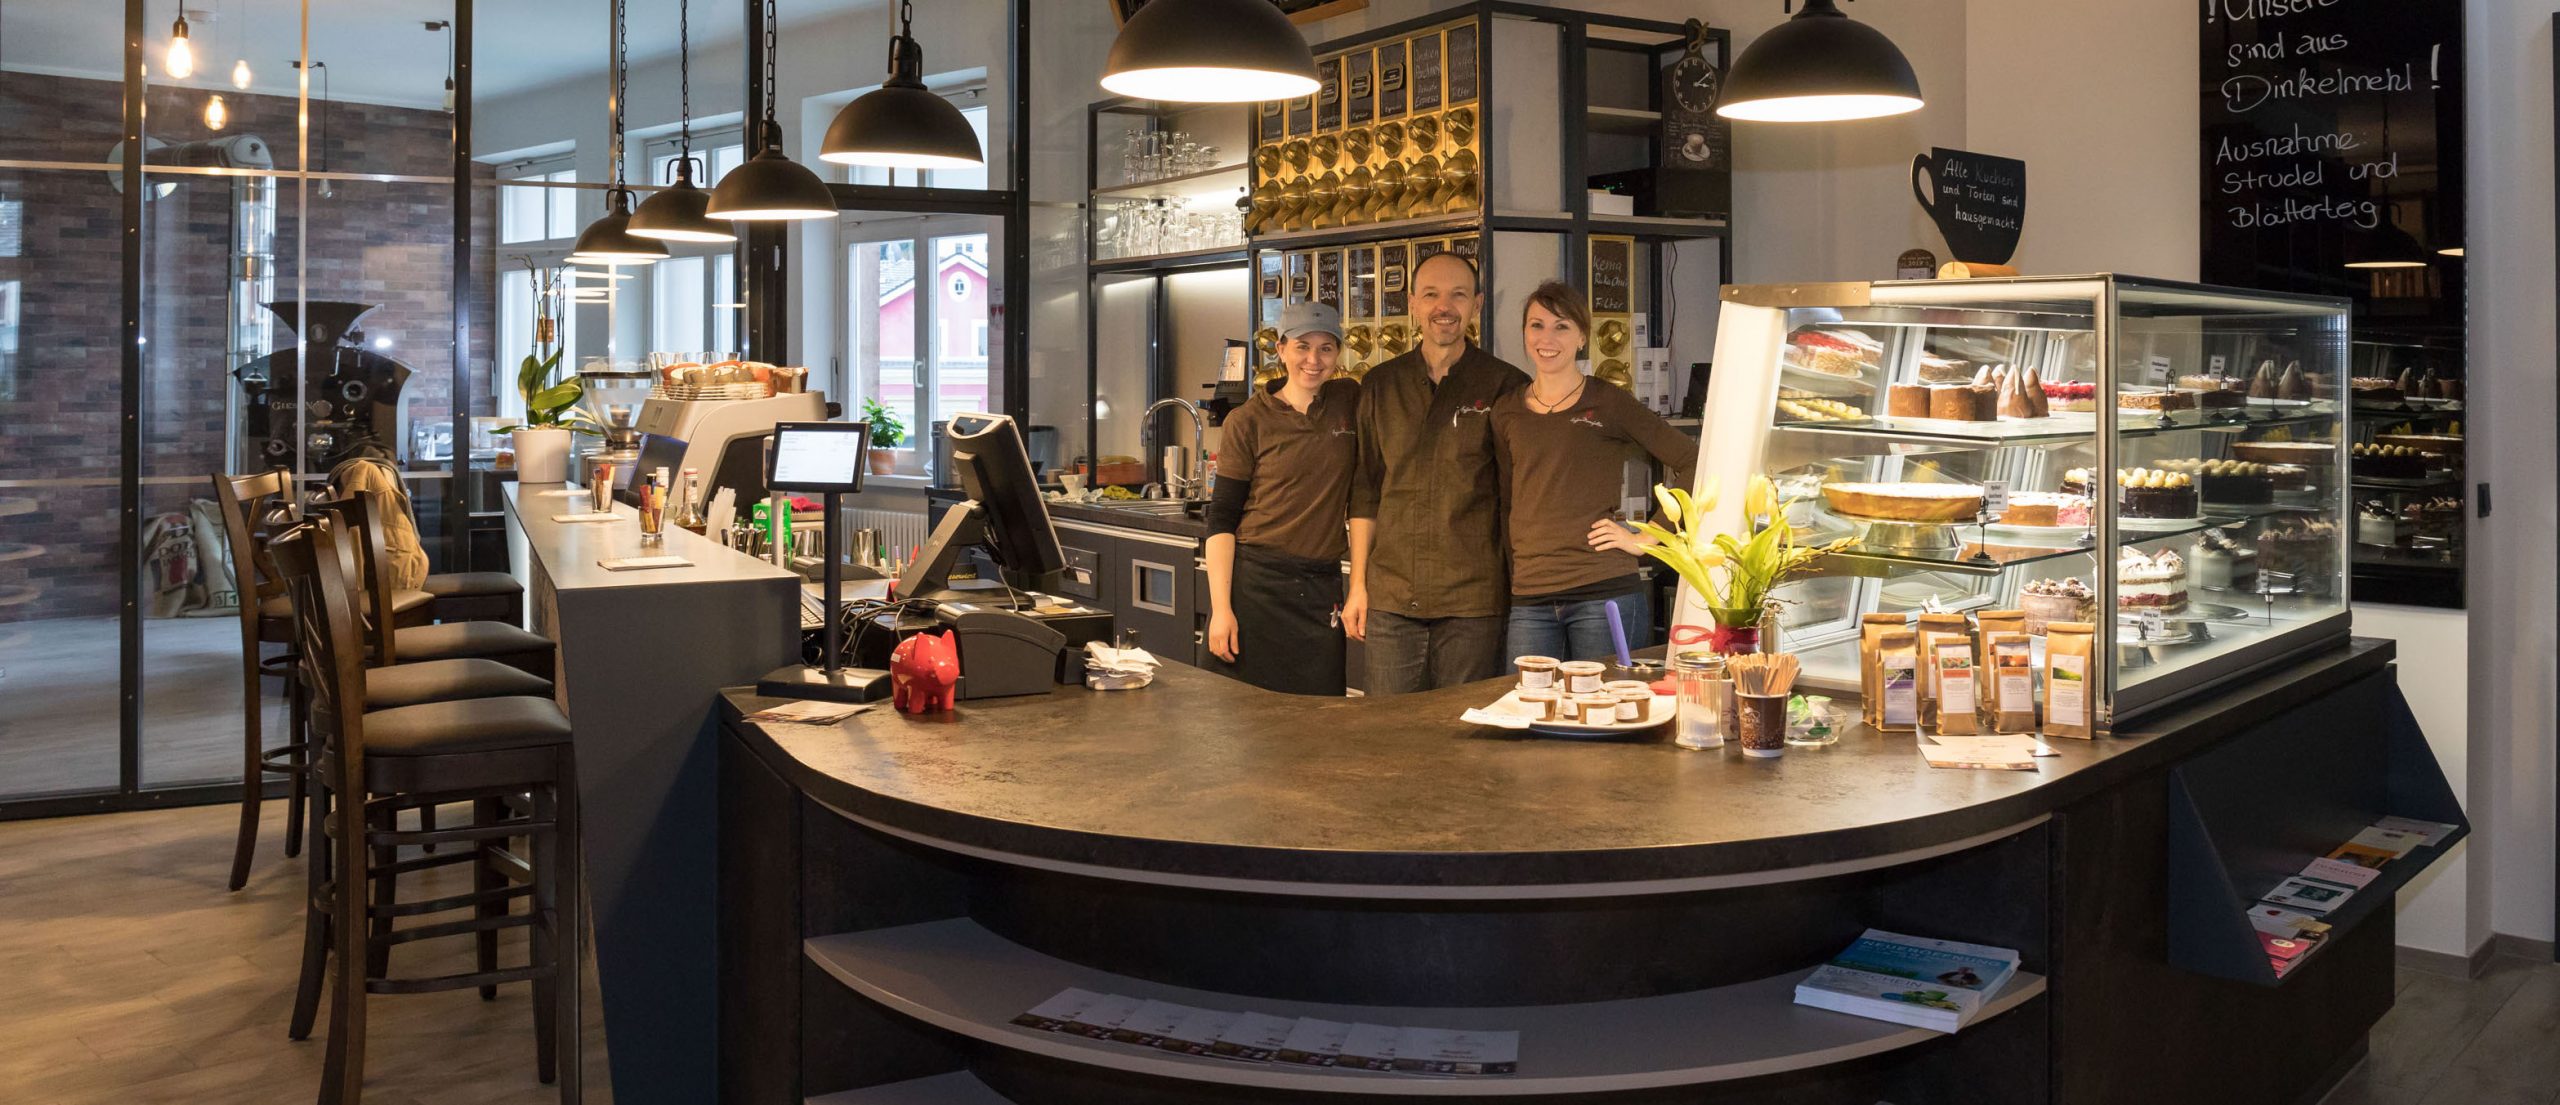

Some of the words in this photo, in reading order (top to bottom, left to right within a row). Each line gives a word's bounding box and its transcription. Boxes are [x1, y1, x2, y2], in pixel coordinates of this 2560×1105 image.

[2296, 33, 2348, 55] aus
[2221, 63, 2412, 113] Dinkelmehl
[1942, 158, 1968, 179] Alle
[2222, 160, 2323, 194] Strudel
[2349, 152, 2398, 180] und
[1943, 184, 1961, 196] und
[1966, 184, 1996, 202] Torten
[2228, 195, 2378, 229] Blätterteig
